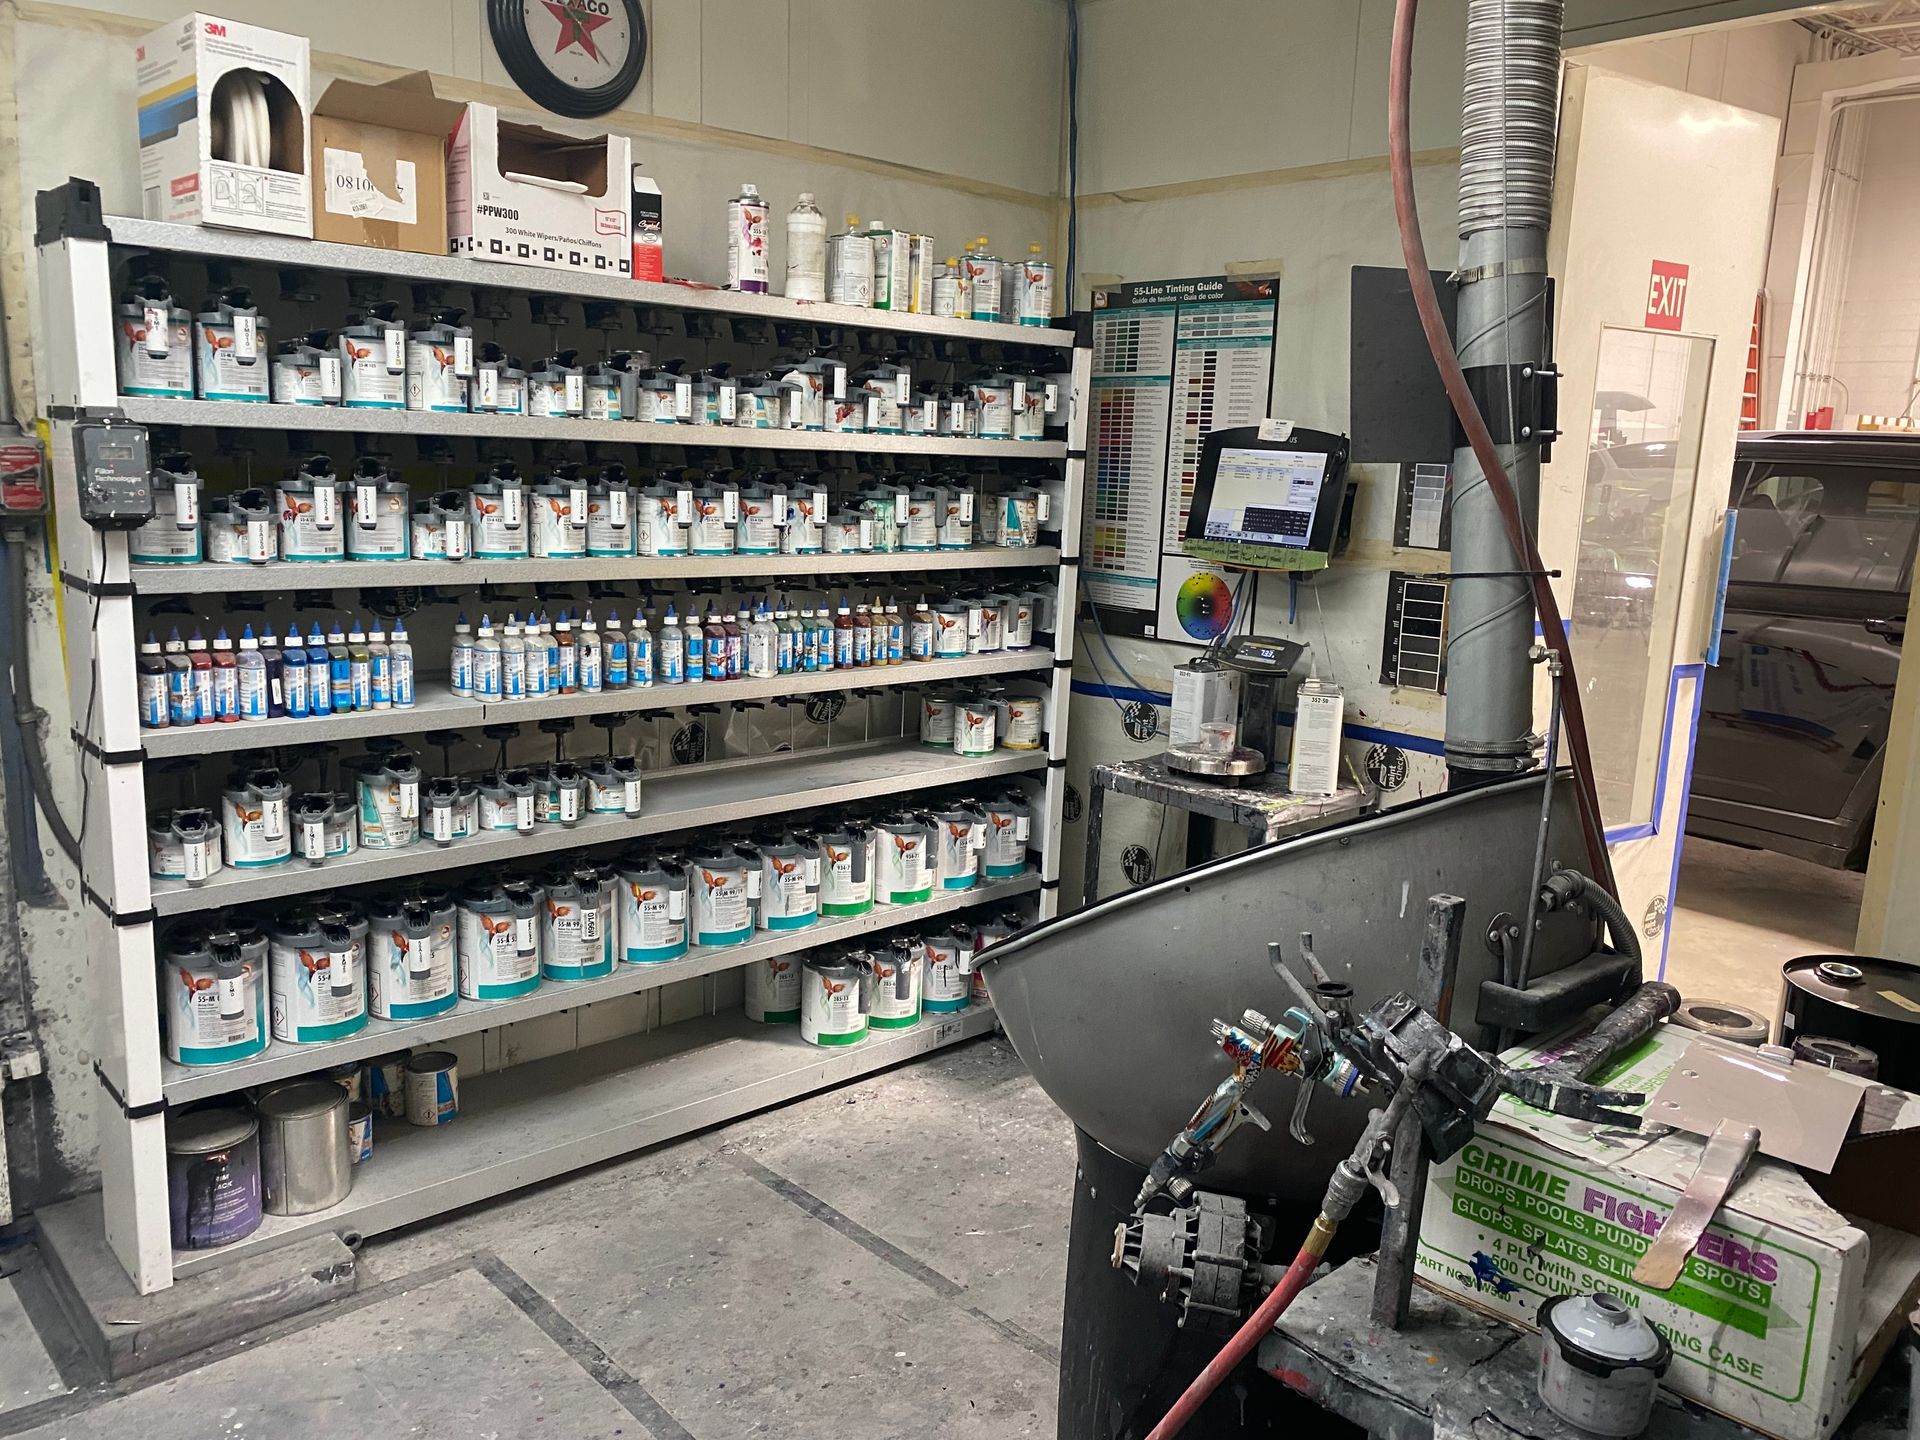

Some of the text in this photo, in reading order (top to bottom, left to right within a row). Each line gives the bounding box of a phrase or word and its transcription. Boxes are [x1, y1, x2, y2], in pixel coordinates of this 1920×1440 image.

[204, 22, 226, 38] 3M
[476, 204, 519, 221] #PPW300
[505, 226, 518, 235] 300
[517, 229, 536, 239] White
[1134, 282, 1223, 295] 55-Line Tinting Guide
[1647, 273, 1687, 318] EXIT
[1457, 1198, 1518, 1235] GLOPS,
[1461, 1144, 1778, 1282] GRIME FIGHERS
[1459, 1169, 1521, 1207] DROPS,
[1525, 1197, 1589, 1234] POOLS,
[1693, 1261, 1767, 1304] SPOTS,
[1415, 1253, 1445, 1273] PART
[1492, 1237, 1501, 1251] 4
[1541, 1259, 1576, 1282] with
[1581, 1273, 1641, 1309] SCRIM
[1708, 1344, 1764, 1381] CASE
